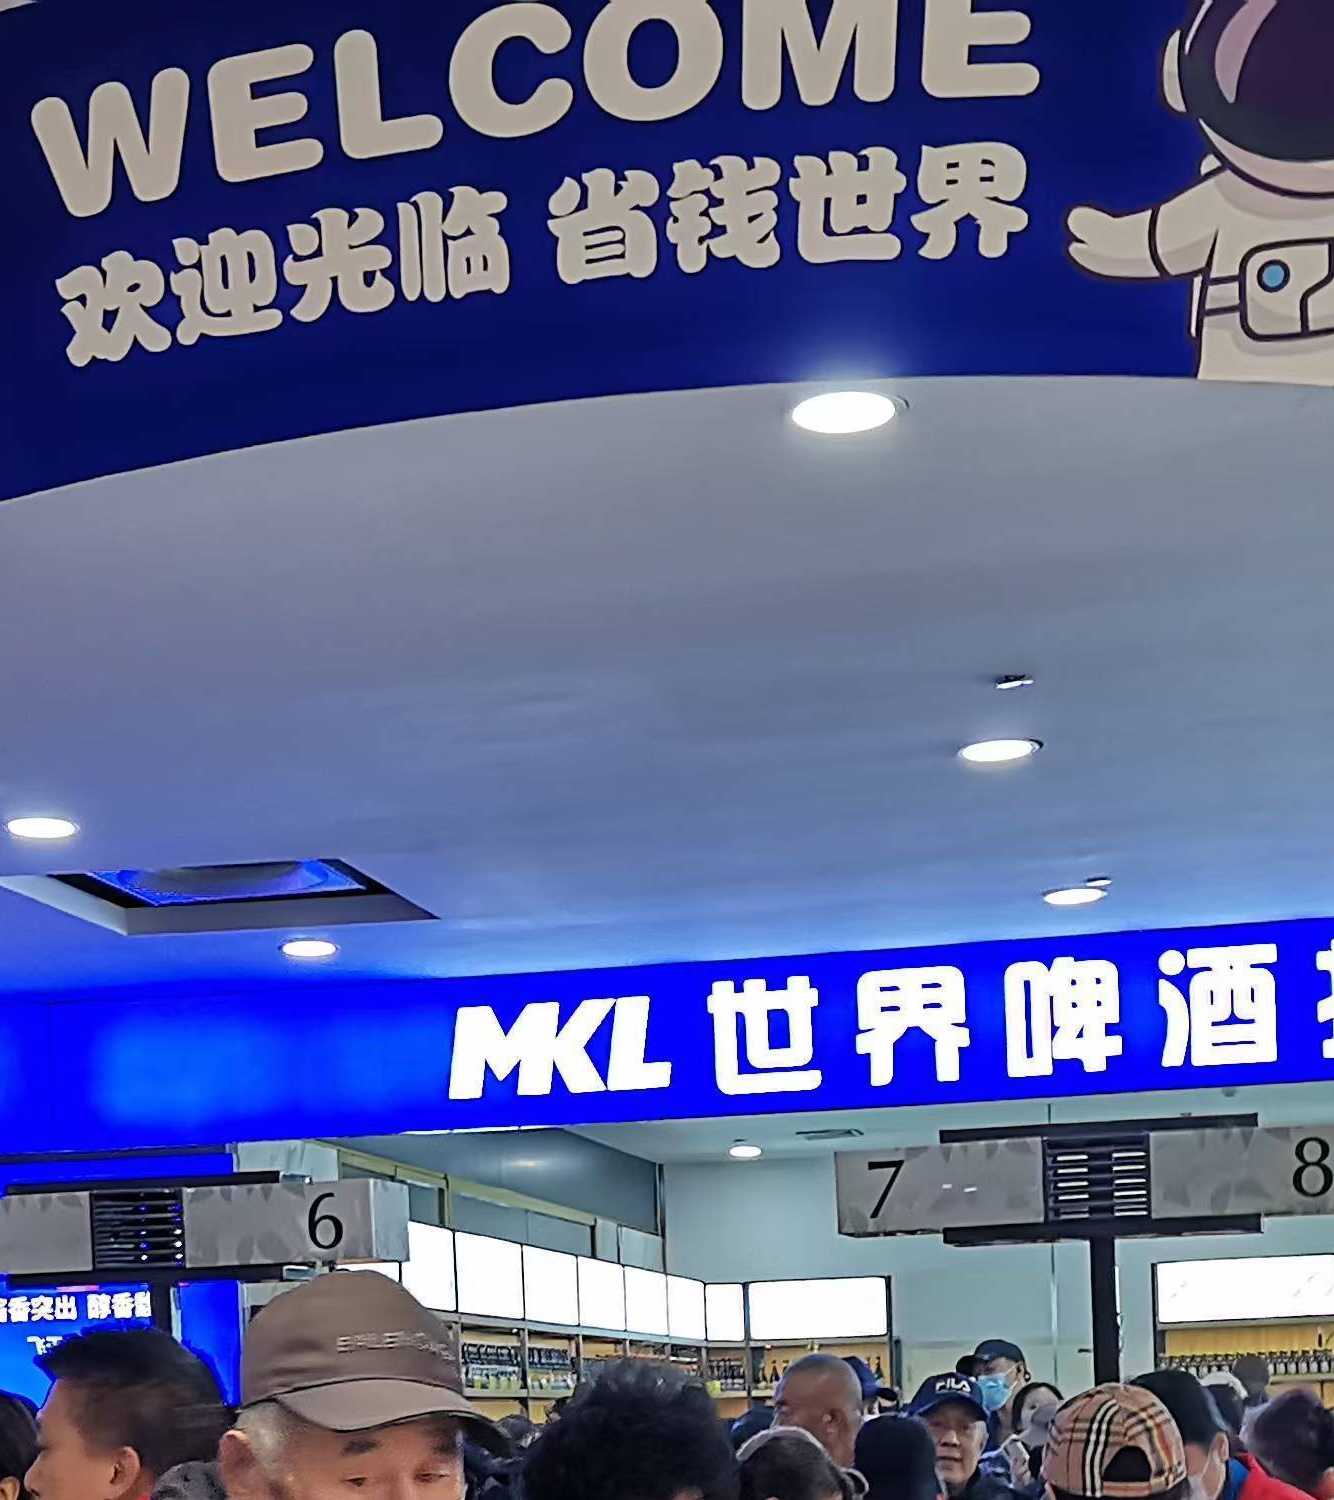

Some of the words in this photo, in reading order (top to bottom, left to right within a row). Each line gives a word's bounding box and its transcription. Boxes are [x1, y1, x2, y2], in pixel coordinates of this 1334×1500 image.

[30, 0, 1041, 217] WELCOME
[54, 185, 510, 368] 欢迎光临
[548, 141, 1028, 284] 省钱世界
[448, 994, 672, 1101] MKL
[307, 1192, 344, 1250] 6
[866, 1159, 906, 1219] 7
[1291, 1135, 1334, 1198] 8
[935, 1377, 972, 1394] FILA
